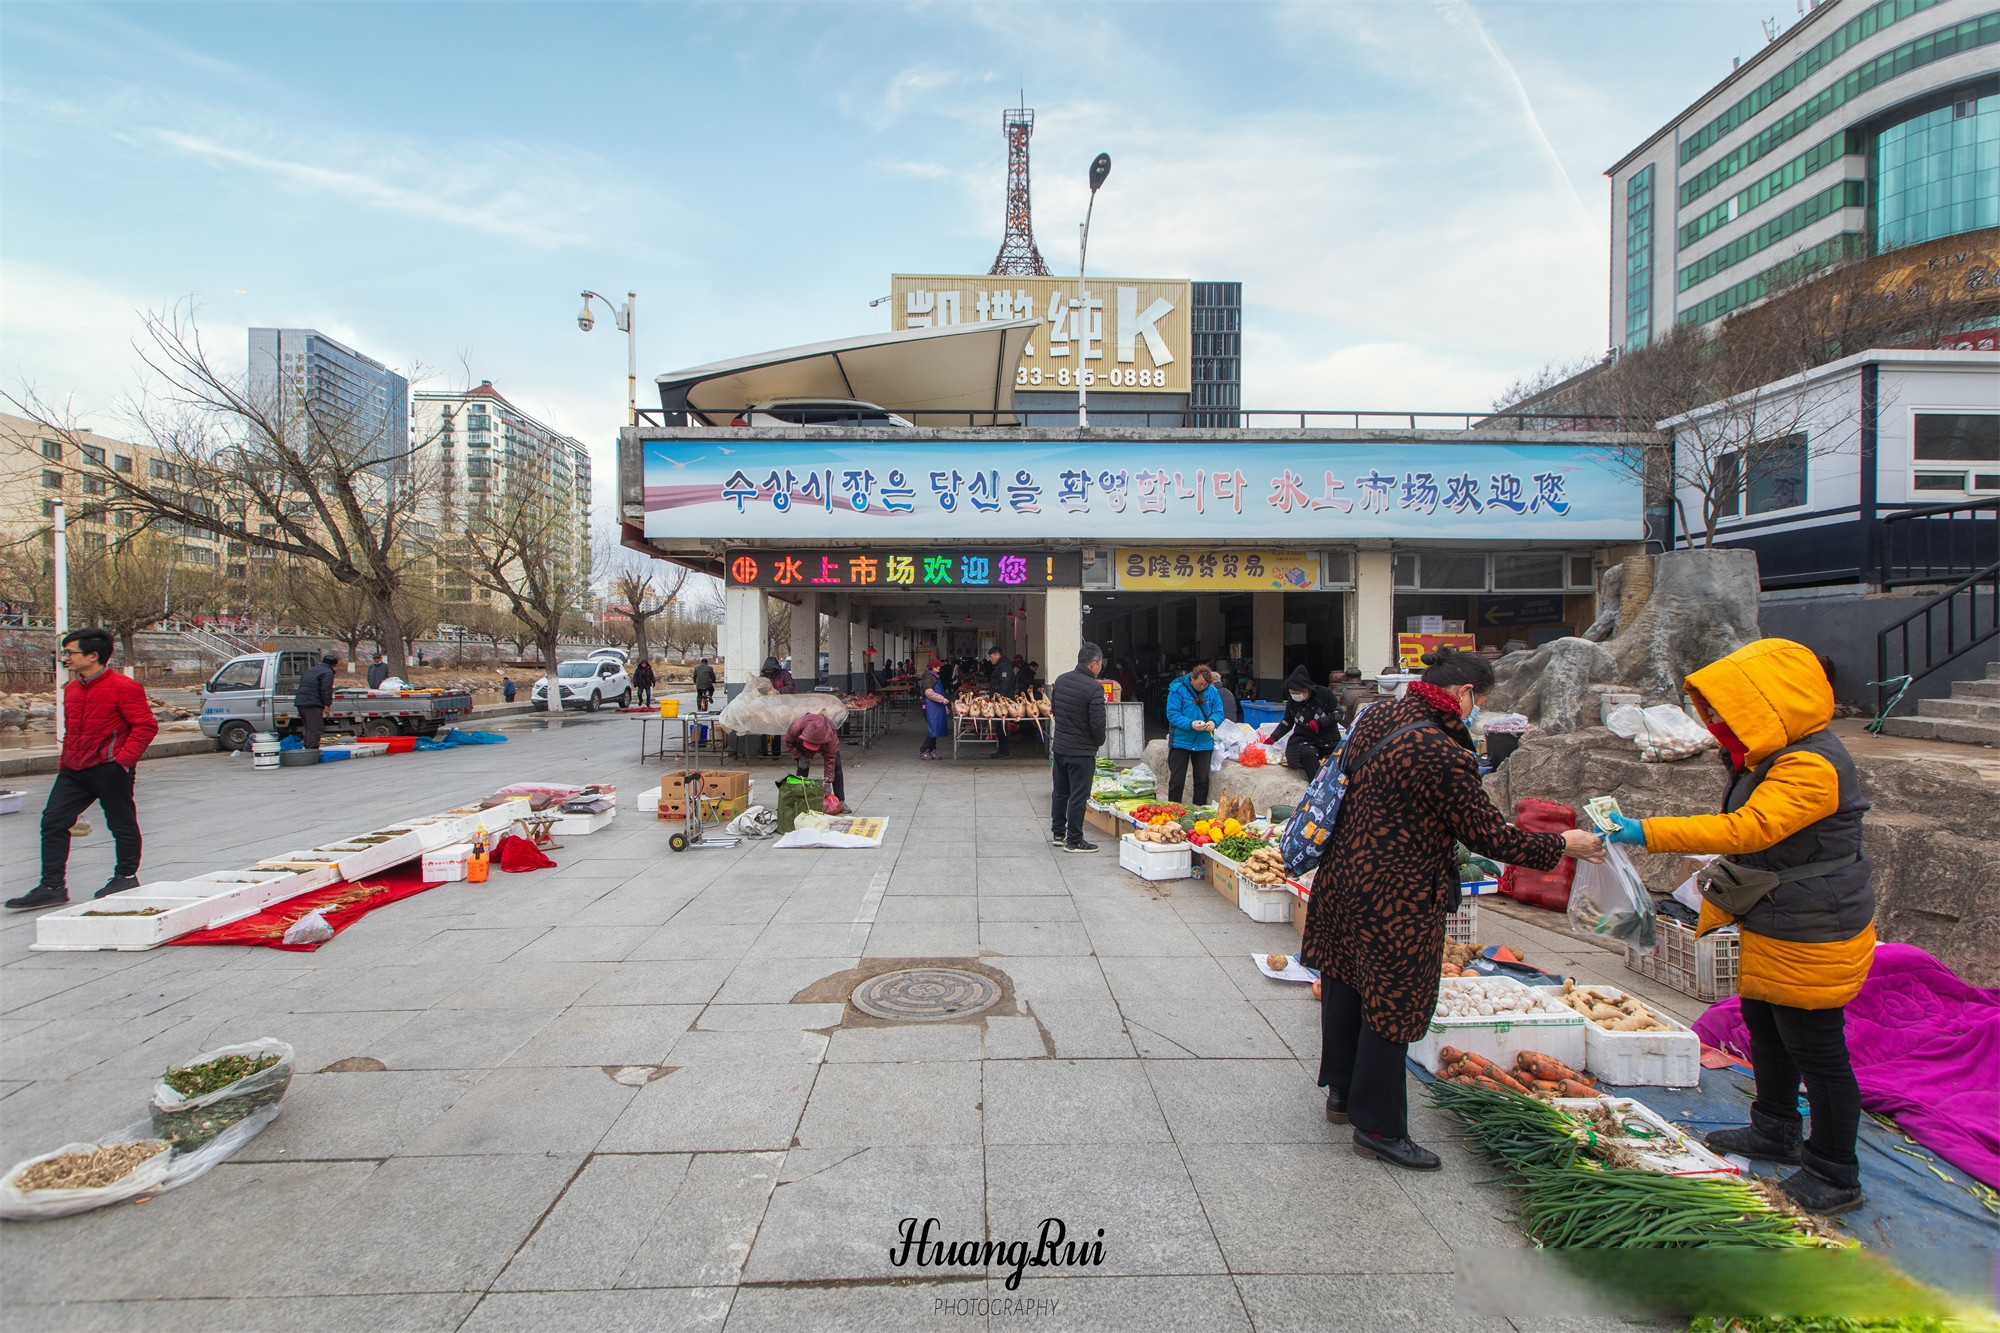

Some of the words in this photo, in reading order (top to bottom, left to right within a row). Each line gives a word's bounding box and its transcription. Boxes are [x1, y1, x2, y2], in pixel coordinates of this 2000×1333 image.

[1928, 250, 1969, 271] KTV
[721, 469, 916, 514] 수상시장은
[928, 469, 1043, 514] 당신을
[1056, 469, 1248, 514] 환영합니다
[1267, 468, 1571, 516] 水上市场欢迎您
[1126, 553, 1265, 579] 昌隆易货贸易
